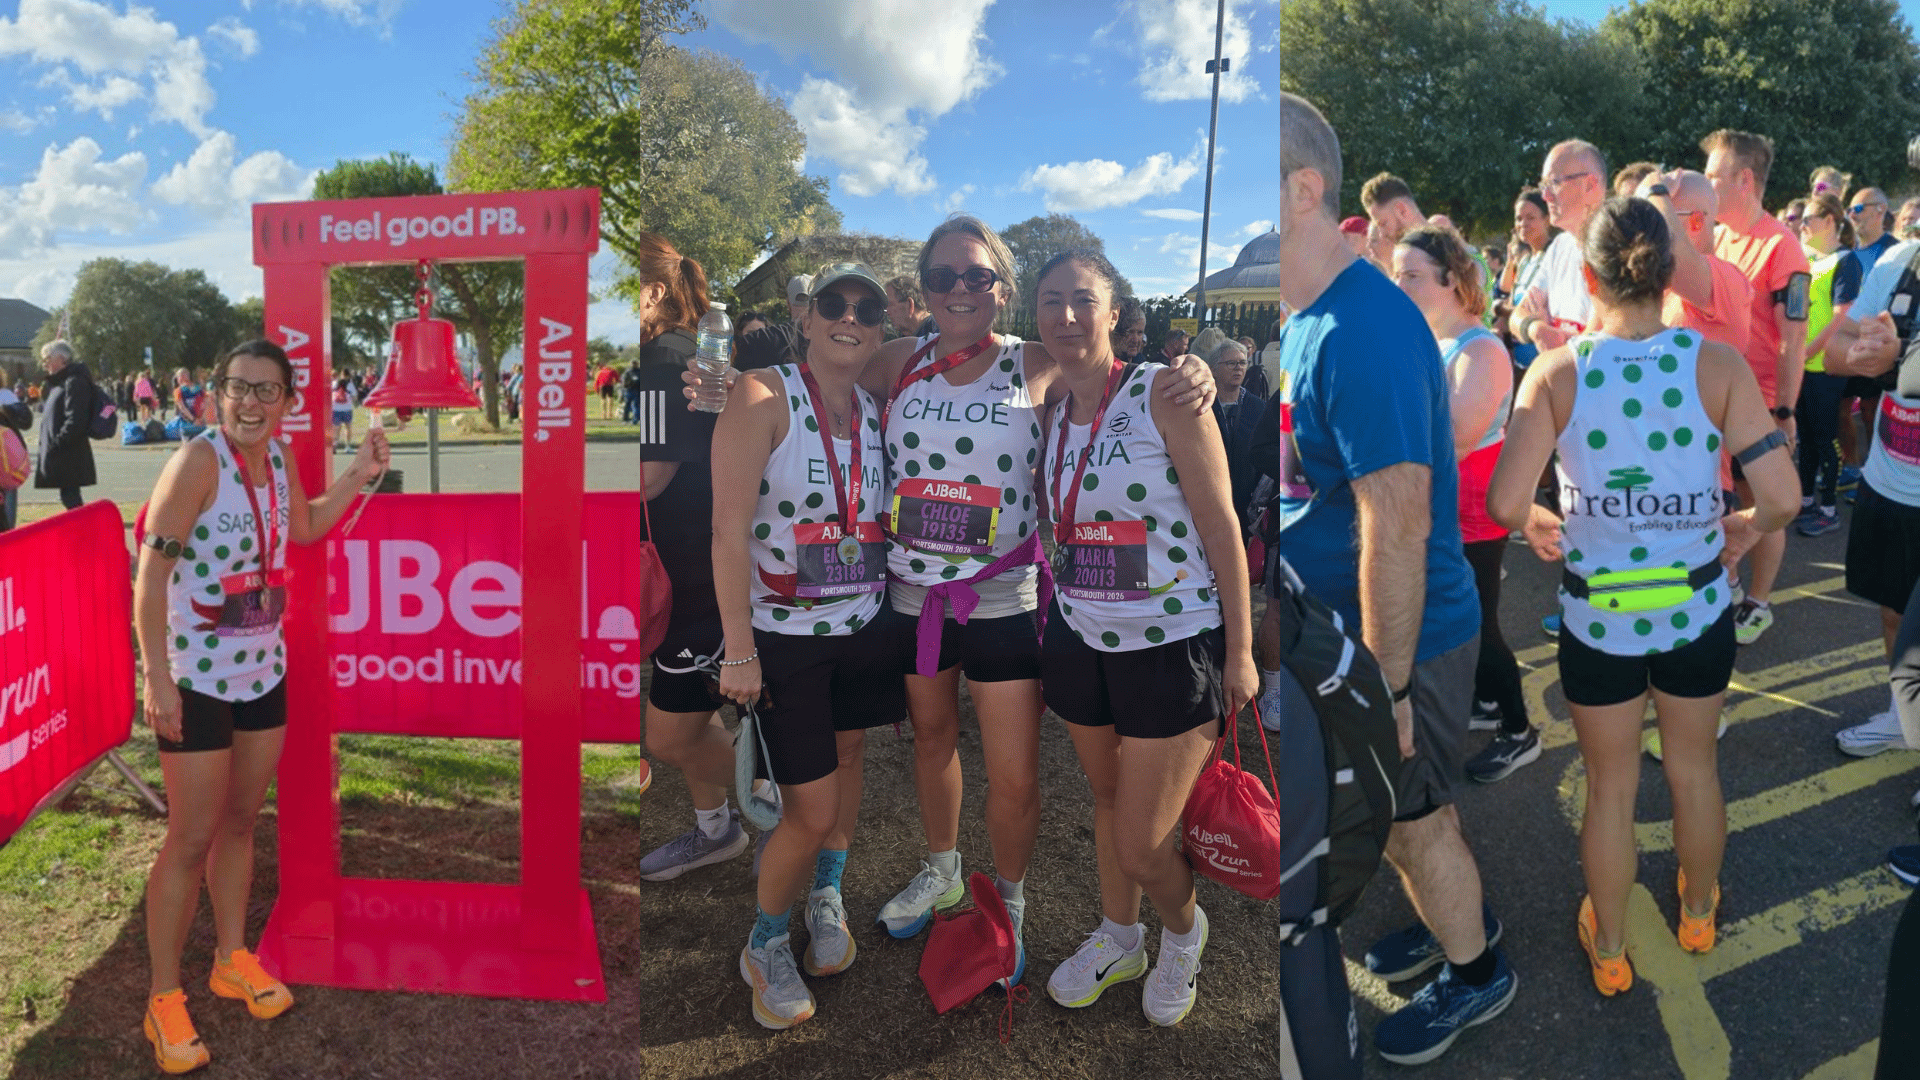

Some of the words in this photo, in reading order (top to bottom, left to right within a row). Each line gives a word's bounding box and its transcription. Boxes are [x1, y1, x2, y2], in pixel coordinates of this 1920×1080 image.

[320, 211, 380, 243] Feel
[386, 207, 474, 246] good
[480, 207, 527, 236] PB.
[902, 398, 1009, 426] CHLOE
[1564, 484, 1721, 519] Treloar's
[921, 502, 971, 524] CHLOE
[921, 520, 968, 542] 19135
[912, 539, 954, 553] PORTSMOUTH
[955, 545, 971, 554] 2026
[1074, 547, 1117, 567] MARIA
[826, 563, 866, 583] 23189
[1074, 567, 1116, 587] 20013
[820, 586, 858, 596] PORTSMOUTH
[858, 584, 872, 593] 2026
[1069, 588, 1105, 600] PORTSMOUTH
[1106, 591, 1125, 600] 2026
[335, 648, 444, 688] good
[0, 663, 51, 729] run
[31, 708, 68, 750] series
[1220, 854, 1250, 867] run
[1239, 869, 1263, 878] series
